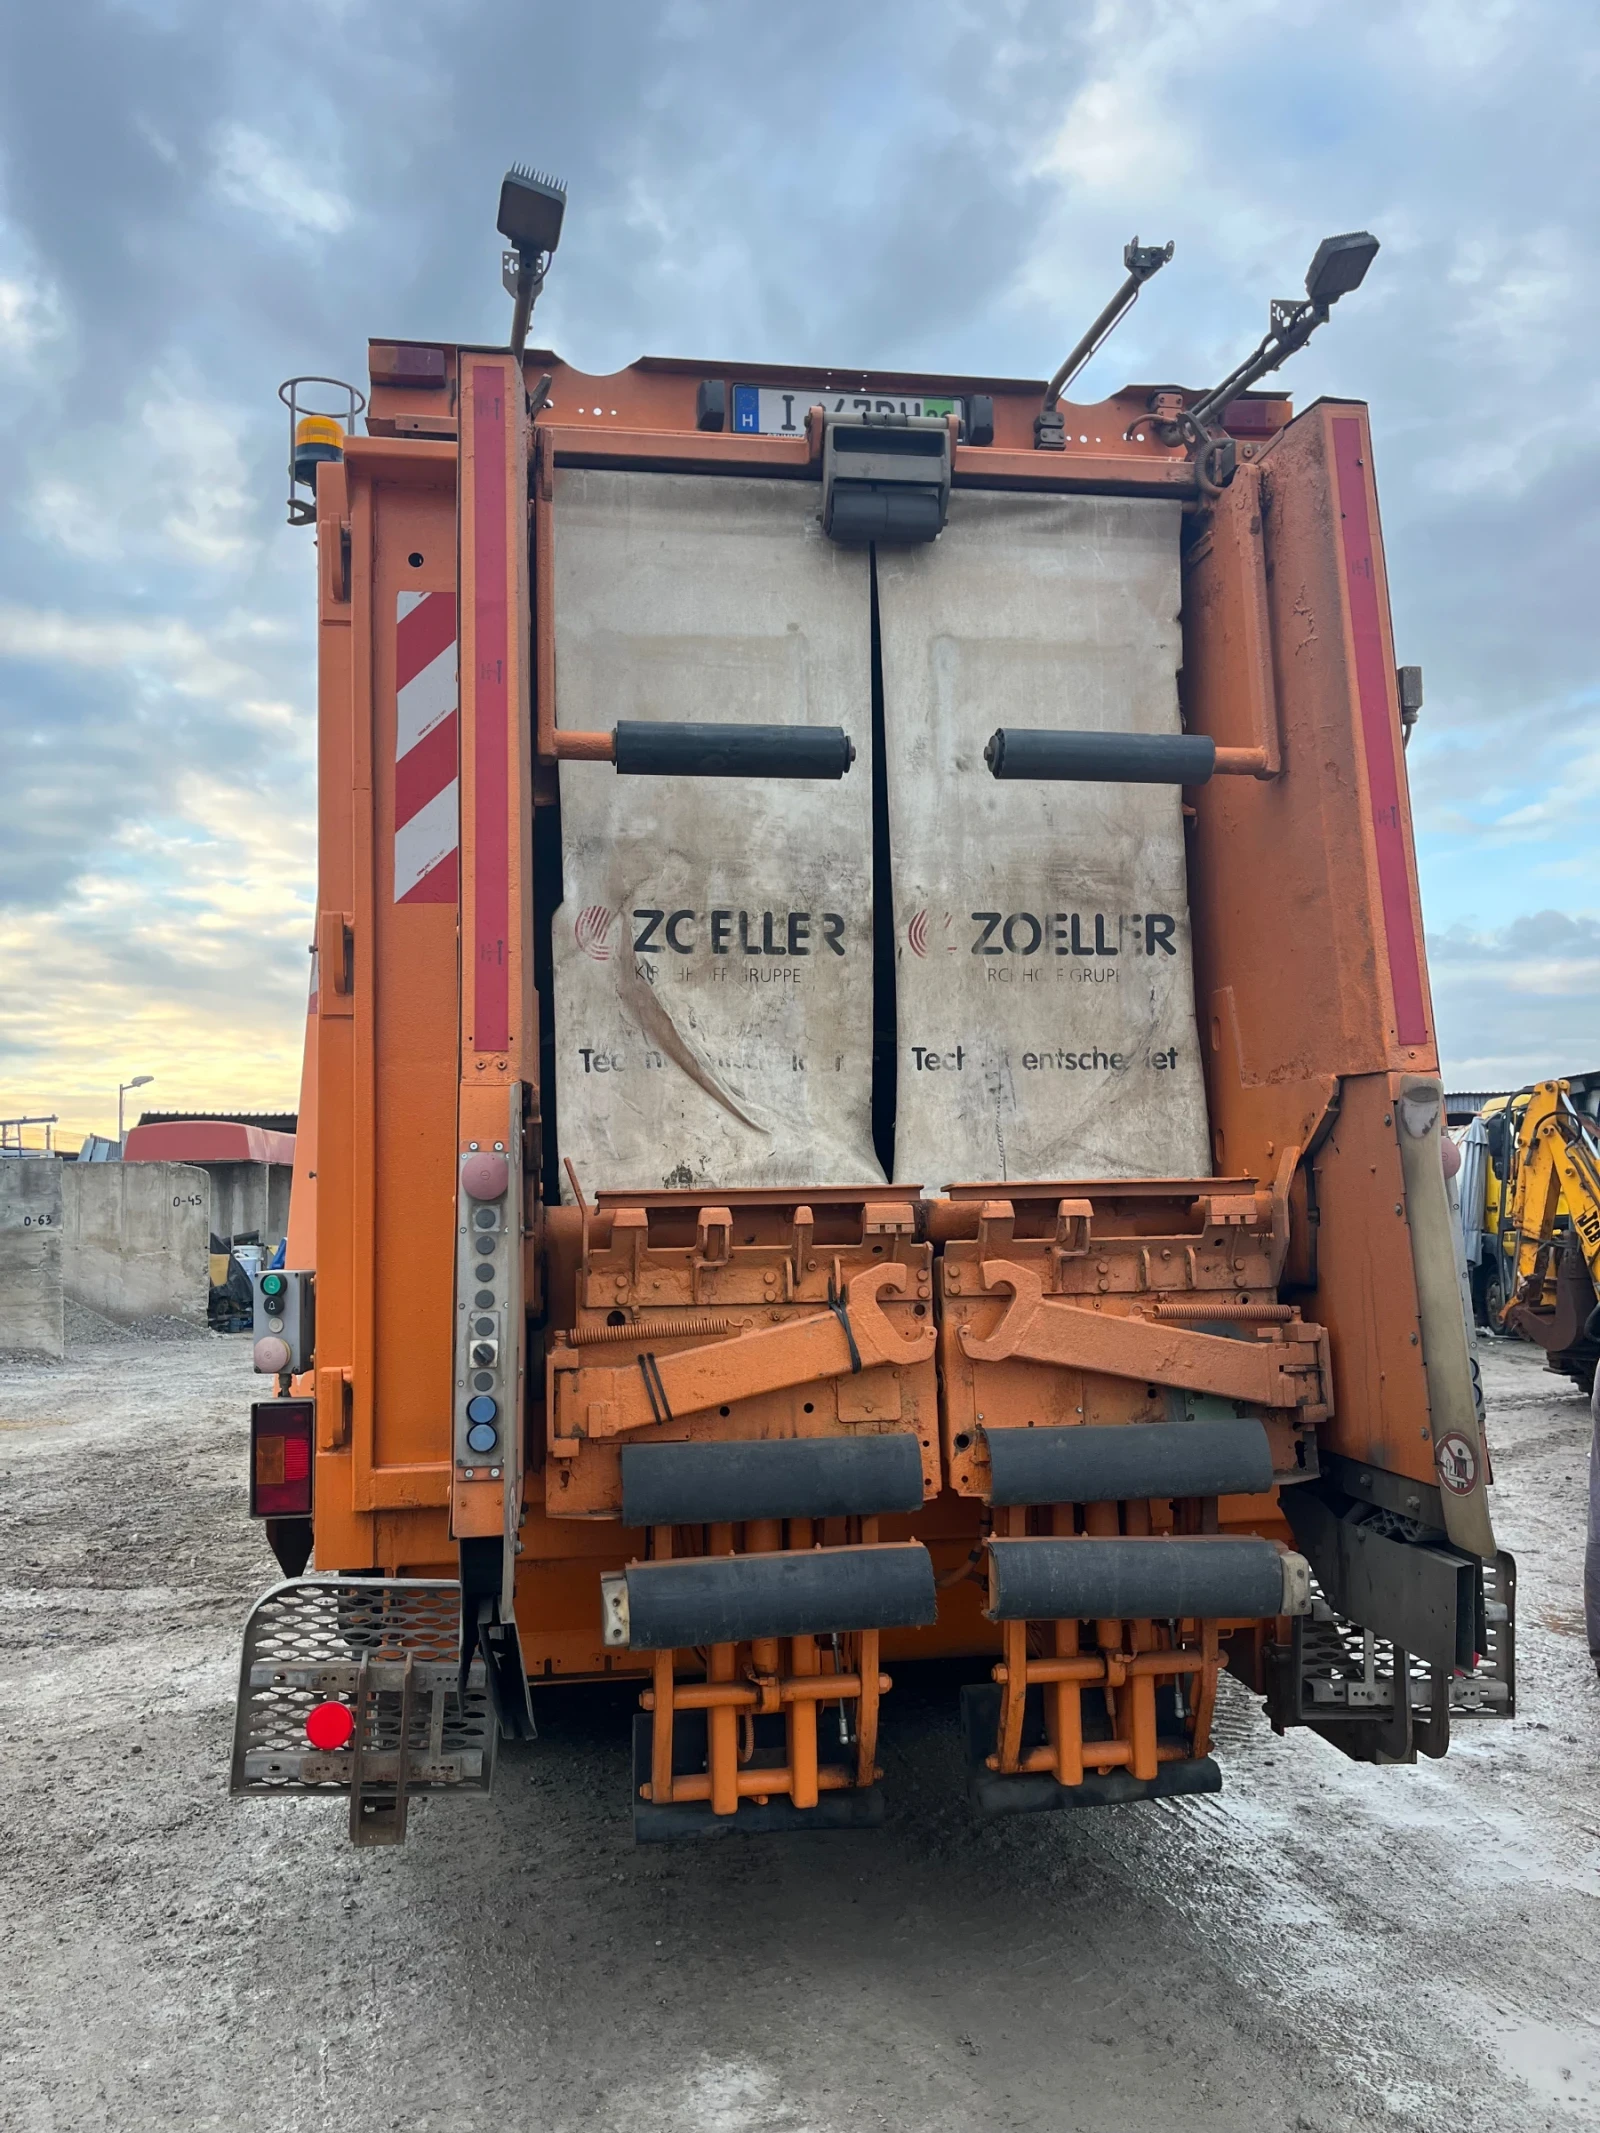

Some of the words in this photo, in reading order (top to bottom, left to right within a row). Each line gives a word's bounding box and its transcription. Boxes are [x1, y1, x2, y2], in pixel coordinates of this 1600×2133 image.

[742, 413, 753, 427] H
[172, 1194, 202, 1207] 0-45
[23, 1214, 52, 1227] 0-63
